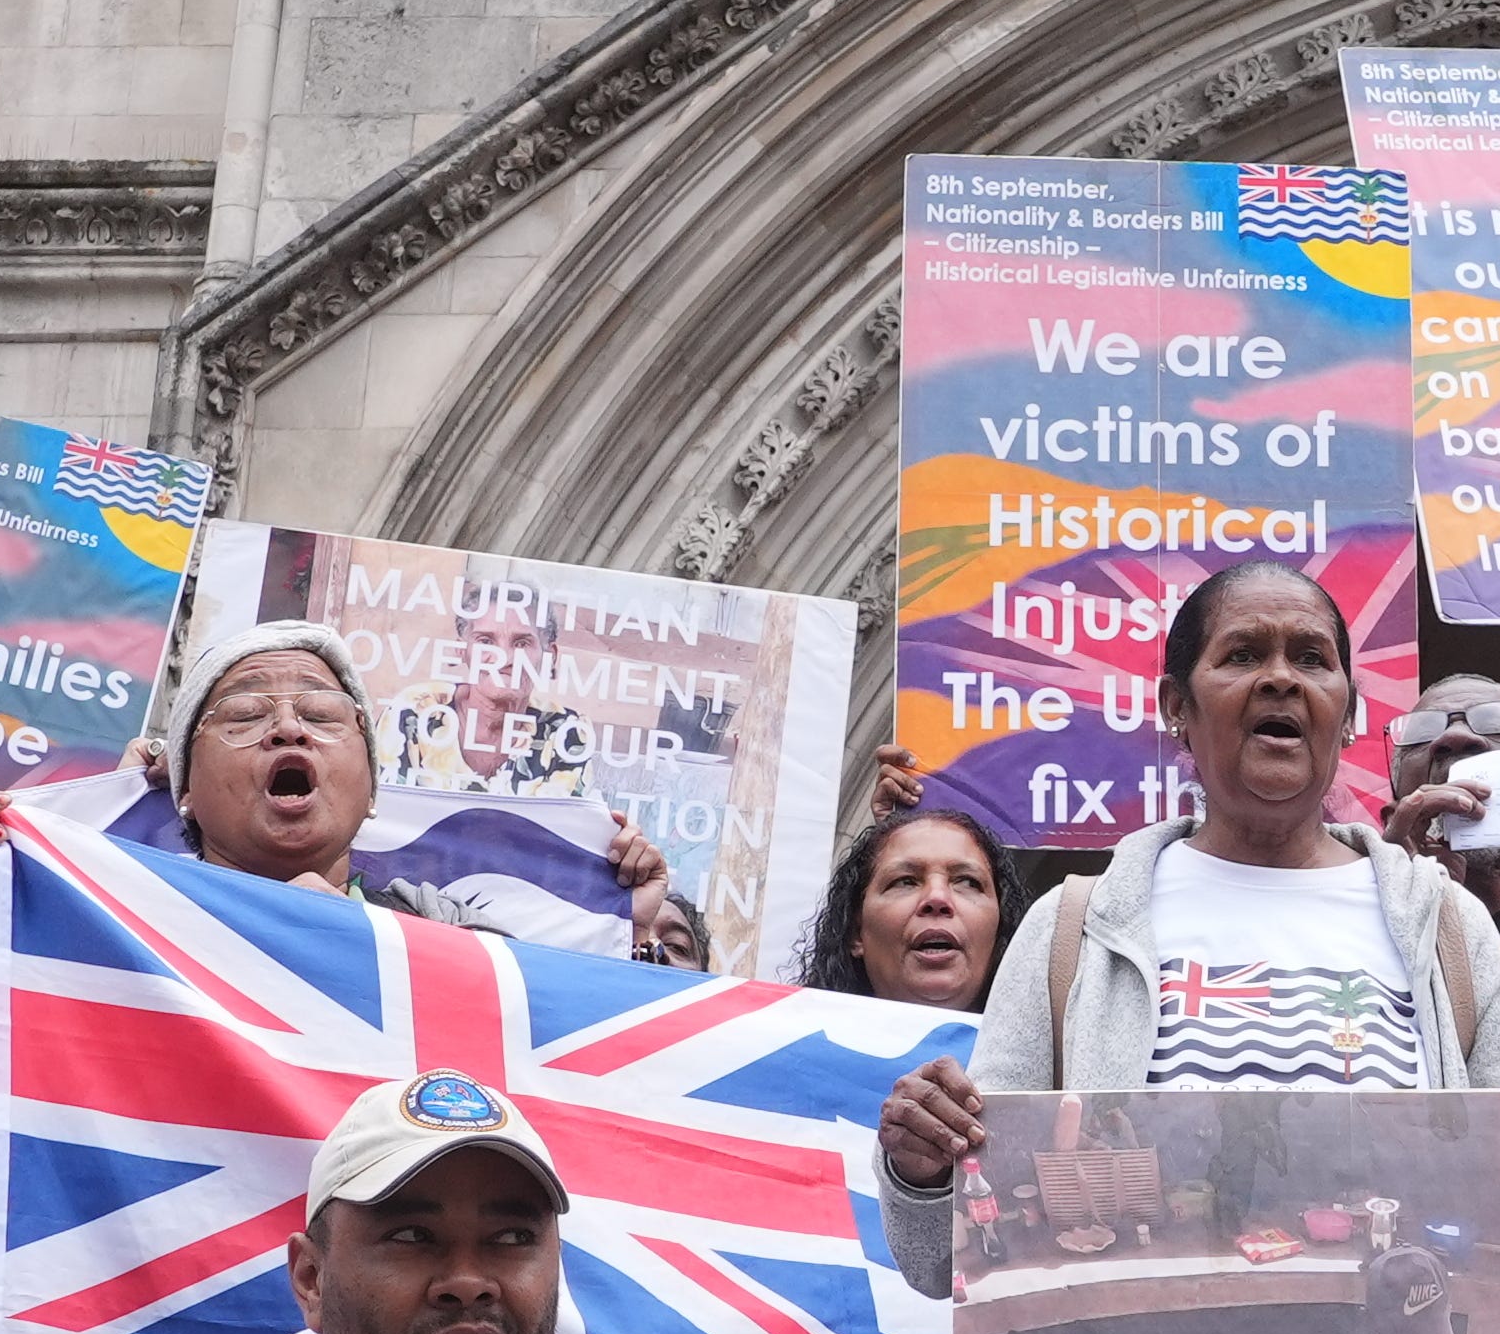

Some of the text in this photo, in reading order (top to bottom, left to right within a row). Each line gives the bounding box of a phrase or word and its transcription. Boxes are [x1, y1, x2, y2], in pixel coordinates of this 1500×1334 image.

[1360, 63, 1395, 81] 8th
[1365, 85, 1482, 107] Nationality
[1372, 132, 1475, 152] Historical
[926, 173, 1115, 210] 8th September,
[925, 203, 1224, 232] Nationality & Borders Bill
[1411, 200, 1428, 236] t
[1440, 200, 1476, 237] is
[945, 231, 1080, 259] Citizenship
[924, 260, 1308, 293] Historical Legislative Unfairness
[1028, 316, 1287, 379] We are
[1426, 371, 1489, 400] on
[980, 403, 1336, 469] victims of
[13, 460, 45, 485] Bill
[987, 493, 1328, 556] Historical
[345, 562, 701, 648] MAURITIAN
[345, 627, 740, 716] OVERNMENT
[942, 670, 1075, 733] The
[553, 712, 684, 771] OUR
[1028, 761, 1117, 824] fix
[695, 870, 756, 920] IN
[1409, 1282, 1438, 1302] NIKE
